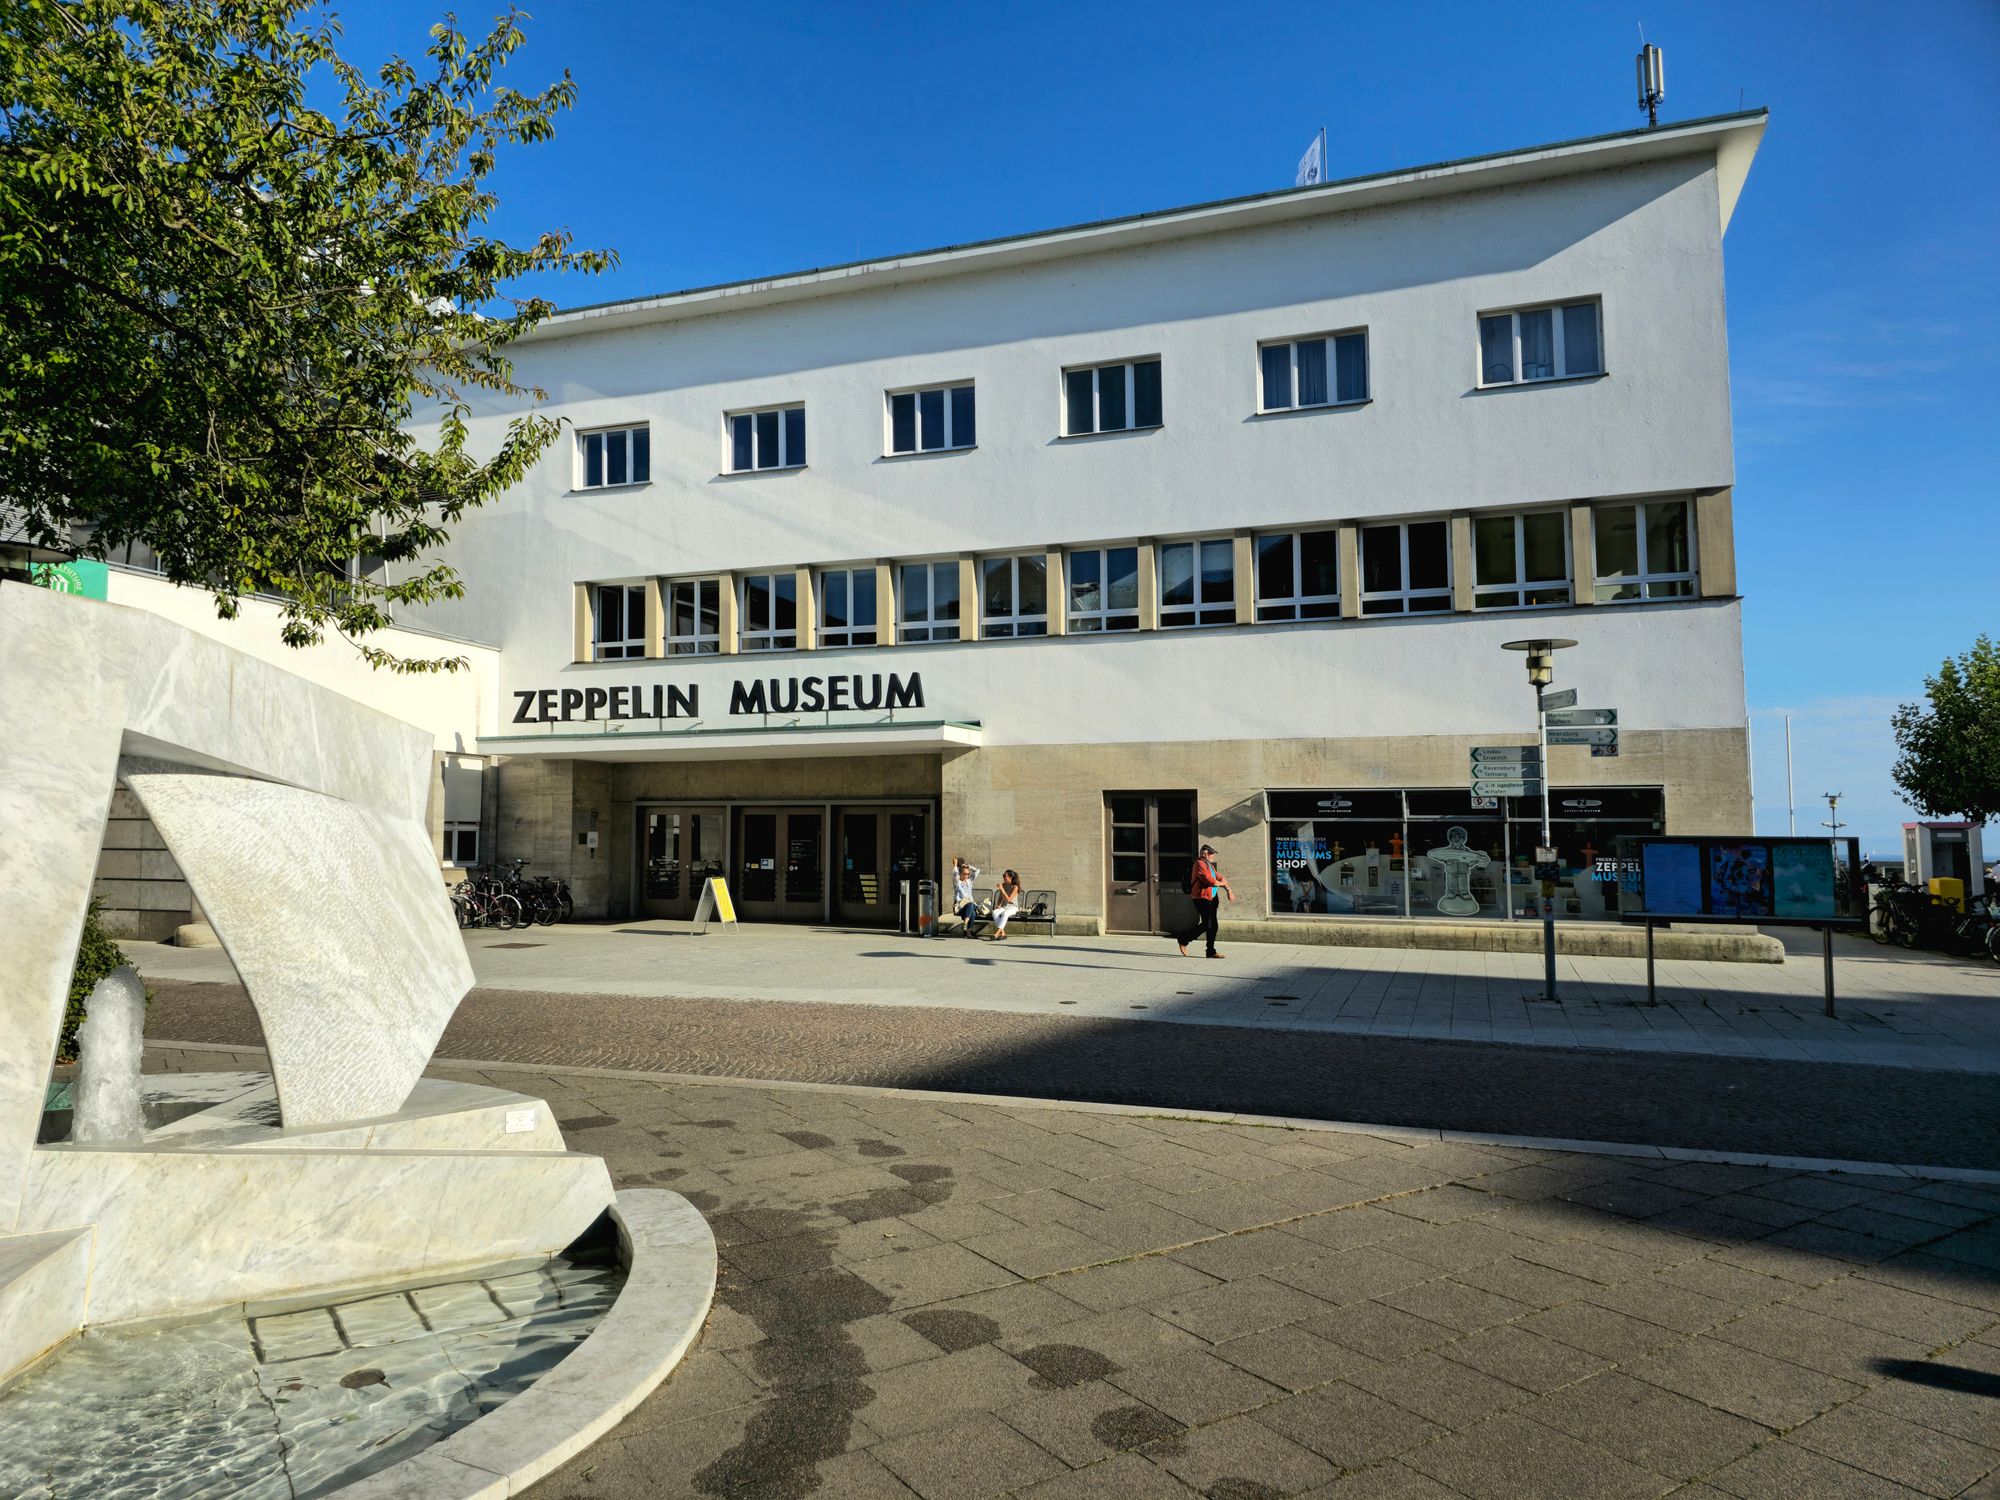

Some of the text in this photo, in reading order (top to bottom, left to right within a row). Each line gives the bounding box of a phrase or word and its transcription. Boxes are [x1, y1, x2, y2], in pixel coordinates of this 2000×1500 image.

[512, 671, 926, 723] ZEPPELIN MUSEUM
[1276, 841, 1327, 850] ZEPPELIN
[1276, 850, 1332, 860] MUSEUMS
[1276, 859, 1307, 868] SHOP
[1596, 862, 1641, 872] ZEPPEL
